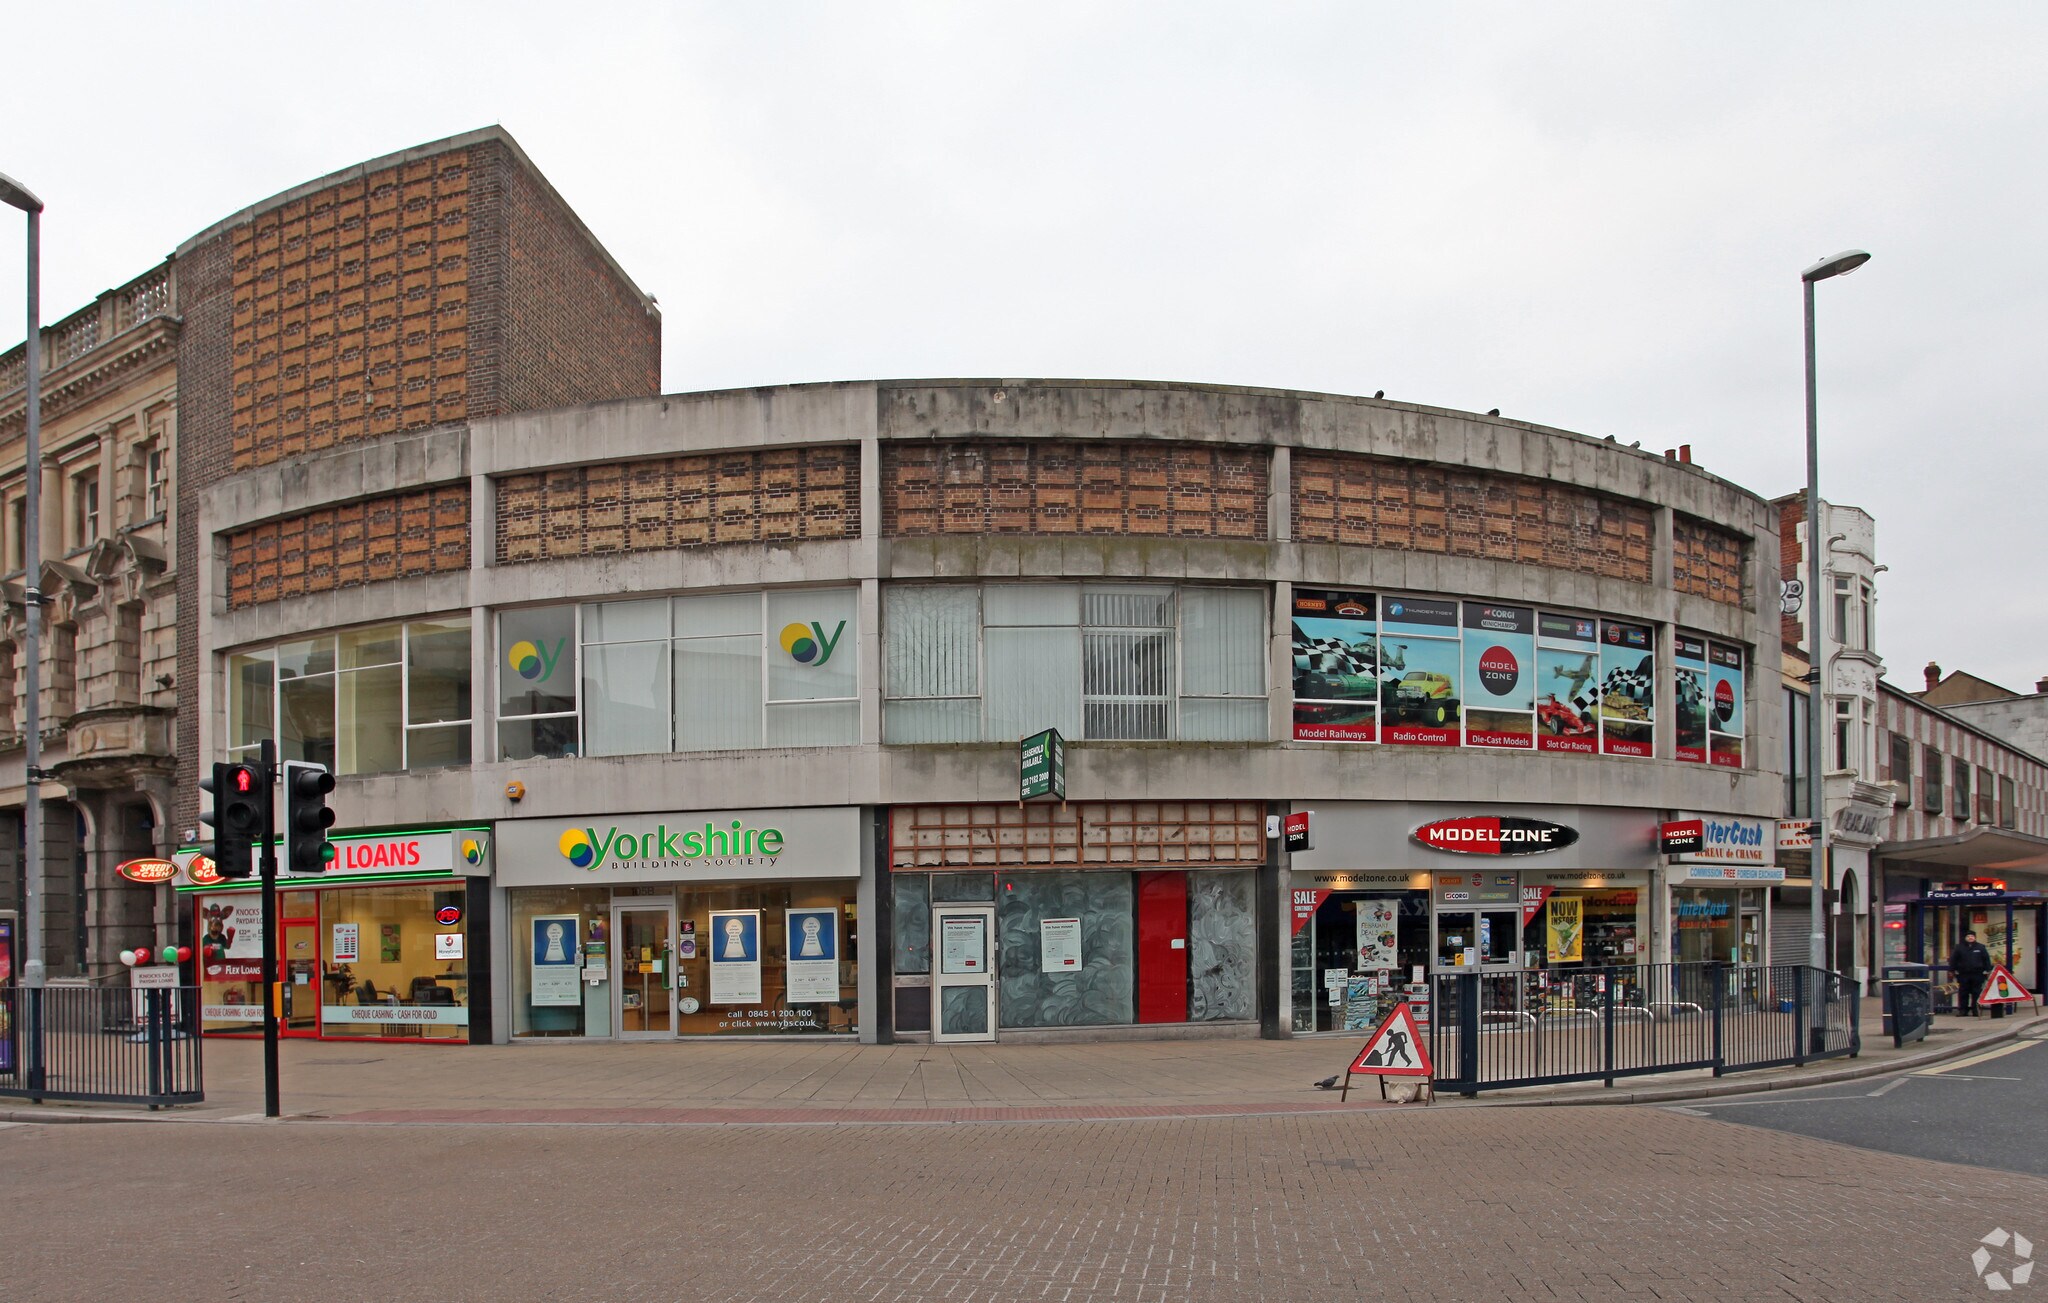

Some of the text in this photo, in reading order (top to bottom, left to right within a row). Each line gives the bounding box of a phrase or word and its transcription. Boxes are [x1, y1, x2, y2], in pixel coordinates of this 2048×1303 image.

[1491, 609, 1515, 619] CORGI
[1482, 620, 1517, 630] MINICHAMPS
[1481, 661, 1517, 671] MODEL
[1485, 672, 1513, 681] ZONE
[1716, 692, 1733, 702] MODEL
[1718, 701, 1731, 709] ZONE
[1299, 729, 1367, 741] Model Railways
[1393, 732, 1447, 742] Radio Control
[1472, 735, 1529, 746] Die-Cast Models
[1546, 740, 1559, 749] Slot
[1571, 742, 1592, 752] Racing
[1613, 744, 1642, 755] Model Kits
[1022, 744, 1044, 760] LEASEHOLD
[1676, 750, 1699, 760] ollectables
[1022, 755, 1043, 769] AVAILABLE
[1287, 823, 1306, 832] MODEL
[1780, 822, 1808, 830] BURE
[1289, 833, 1304, 841] ZONE
[1429, 828, 1552, 843] MODELZONE
[1666, 829, 1698, 837] MODEL
[586, 819, 784, 871] Yorkshire
[346, 841, 420, 869] LOANS
[1726, 850, 1734, 858] de
[1736, 850, 1762, 860] CHANGE
[140, 863, 172, 872] SPEEDY
[611, 857, 778, 870] BUILDING SOCIETY
[1314, 873, 1410, 882] www.modelzone.co.uk
[1547, 871, 1626, 880] www.modelzone.co.uk
[1690, 867, 1783, 879] COMMISSION FREE FOREIGN EXCHANGE
[1294, 891, 1317, 904] SALE
[1523, 887, 1542, 900] SALE
[236, 908, 260, 916] KNOCKS
[1551, 901, 1578, 917] NOW
[1678, 901, 1729, 916] InterCash
[435, 909, 460, 922] OPEN
[1361, 929, 1379, 937] DEALS
[205, 1008, 221, 1017] CHEQUE
[222, 1008, 241, 1017] CASHING
[244, 1008, 256, 1017] CASH
[352, 1009, 438, 1020] CHEQUE CASHING CASH FOR GOLD
[728, 1010, 743, 1018] call
[748, 1010, 769, 1018] 0845
[798, 1009, 812, 1017] 100
[755, 1020, 816, 1029] www.ybs.co.uk
